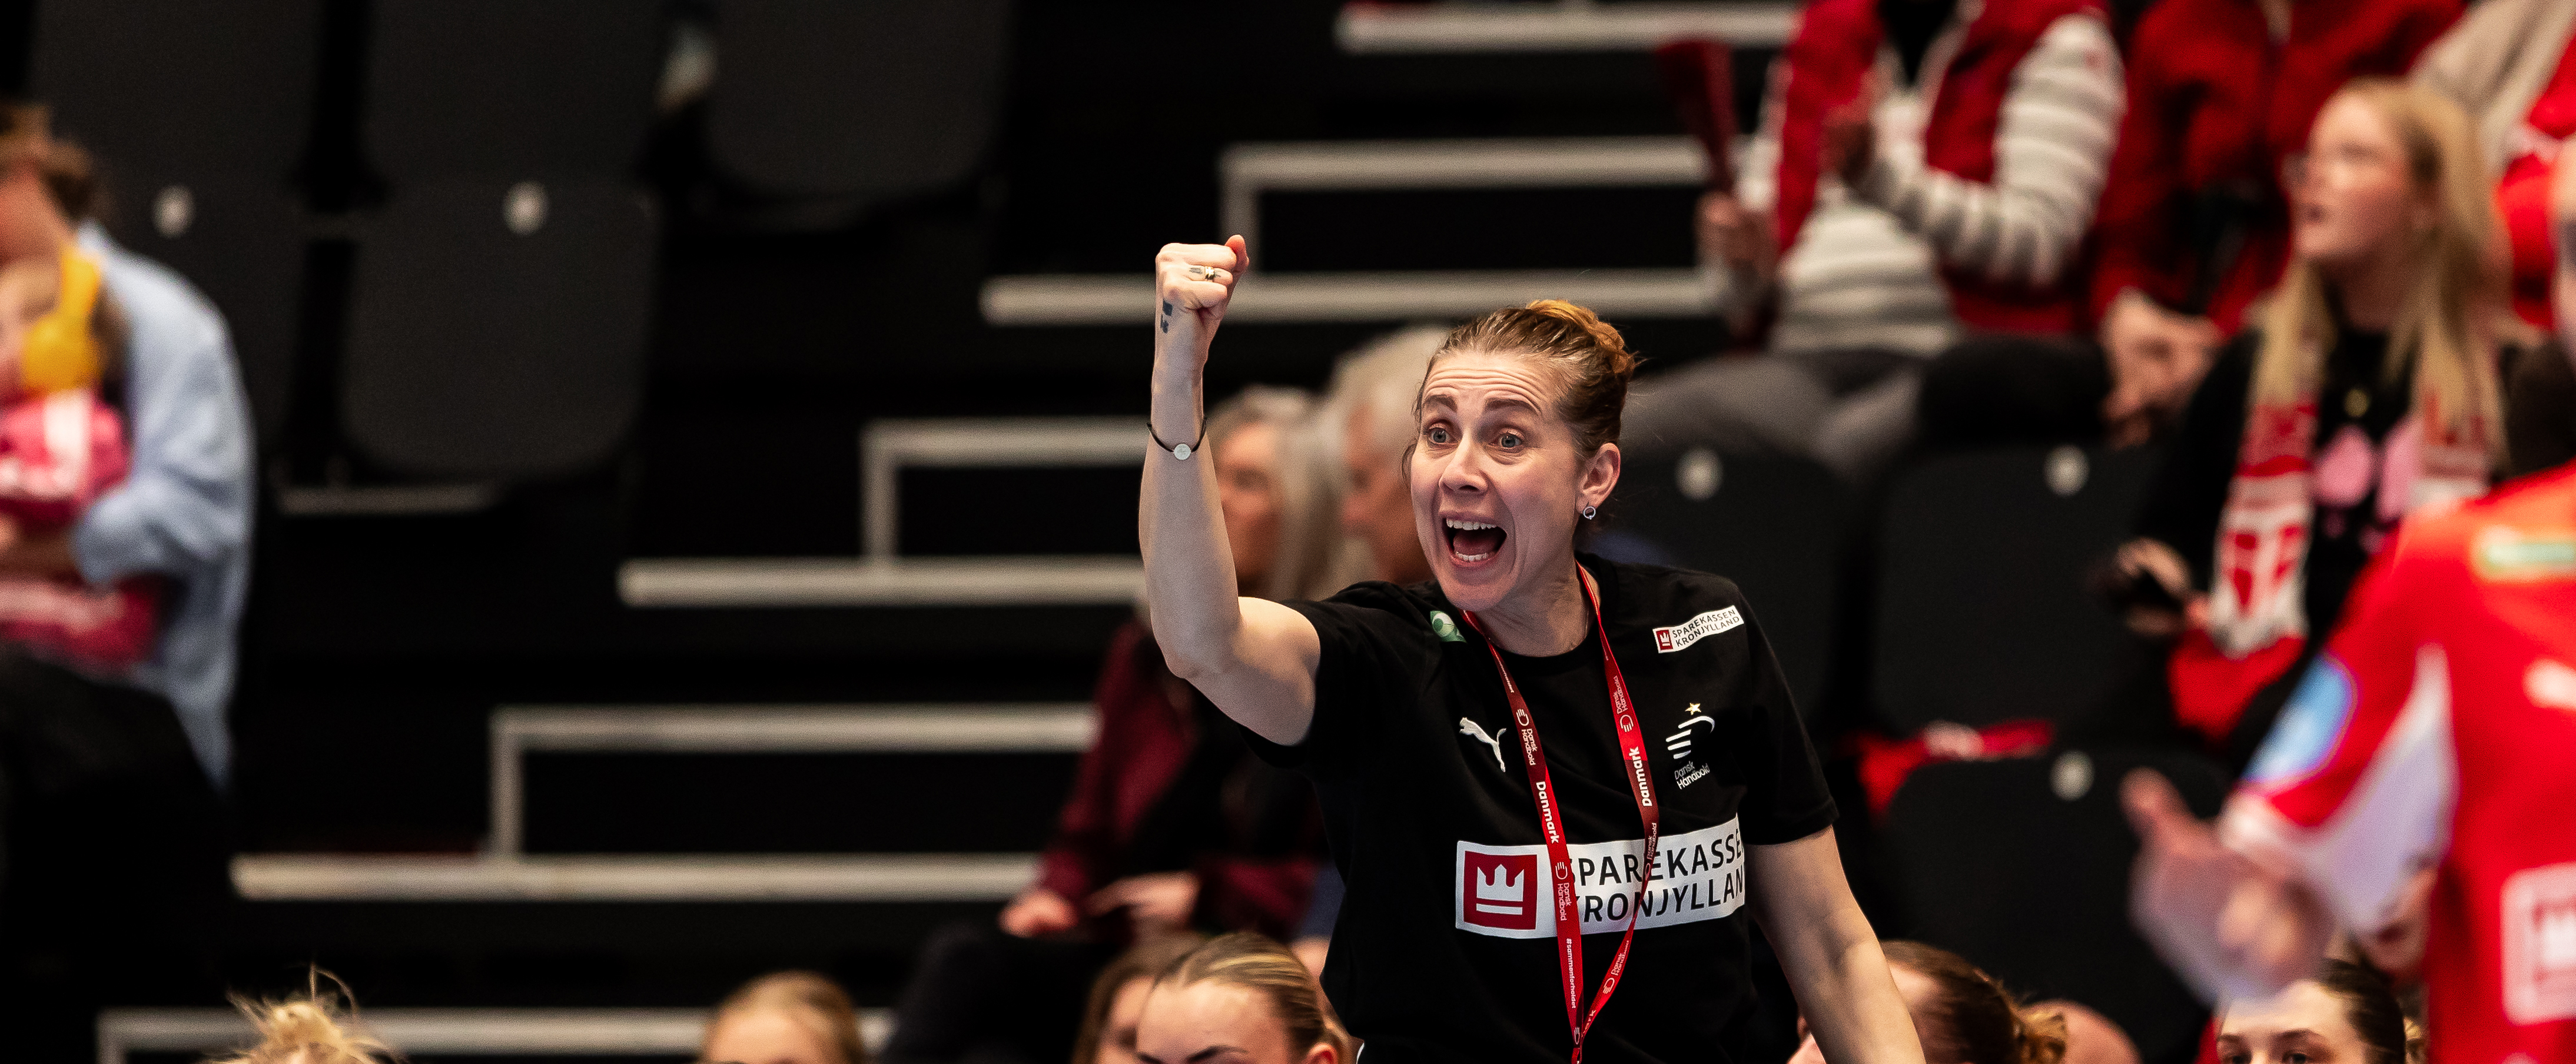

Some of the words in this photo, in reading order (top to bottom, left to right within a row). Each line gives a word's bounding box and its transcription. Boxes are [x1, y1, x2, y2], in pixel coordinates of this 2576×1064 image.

[1672, 609, 1735, 638] SPAREKASSEN
[1675, 616, 1740, 647] KRONJYLLAND
[1526, 729, 1538, 752] Dansk
[1629, 746, 1652, 807] Danmark
[1674, 760, 1695, 780] Dansk
[1536, 782, 1559, 844] Danmark
[1570, 829, 1744, 886] PAREKASSE
[1563, 883, 1572, 906] Dansk
[1576, 862, 1745, 923] RONJYLLAN
